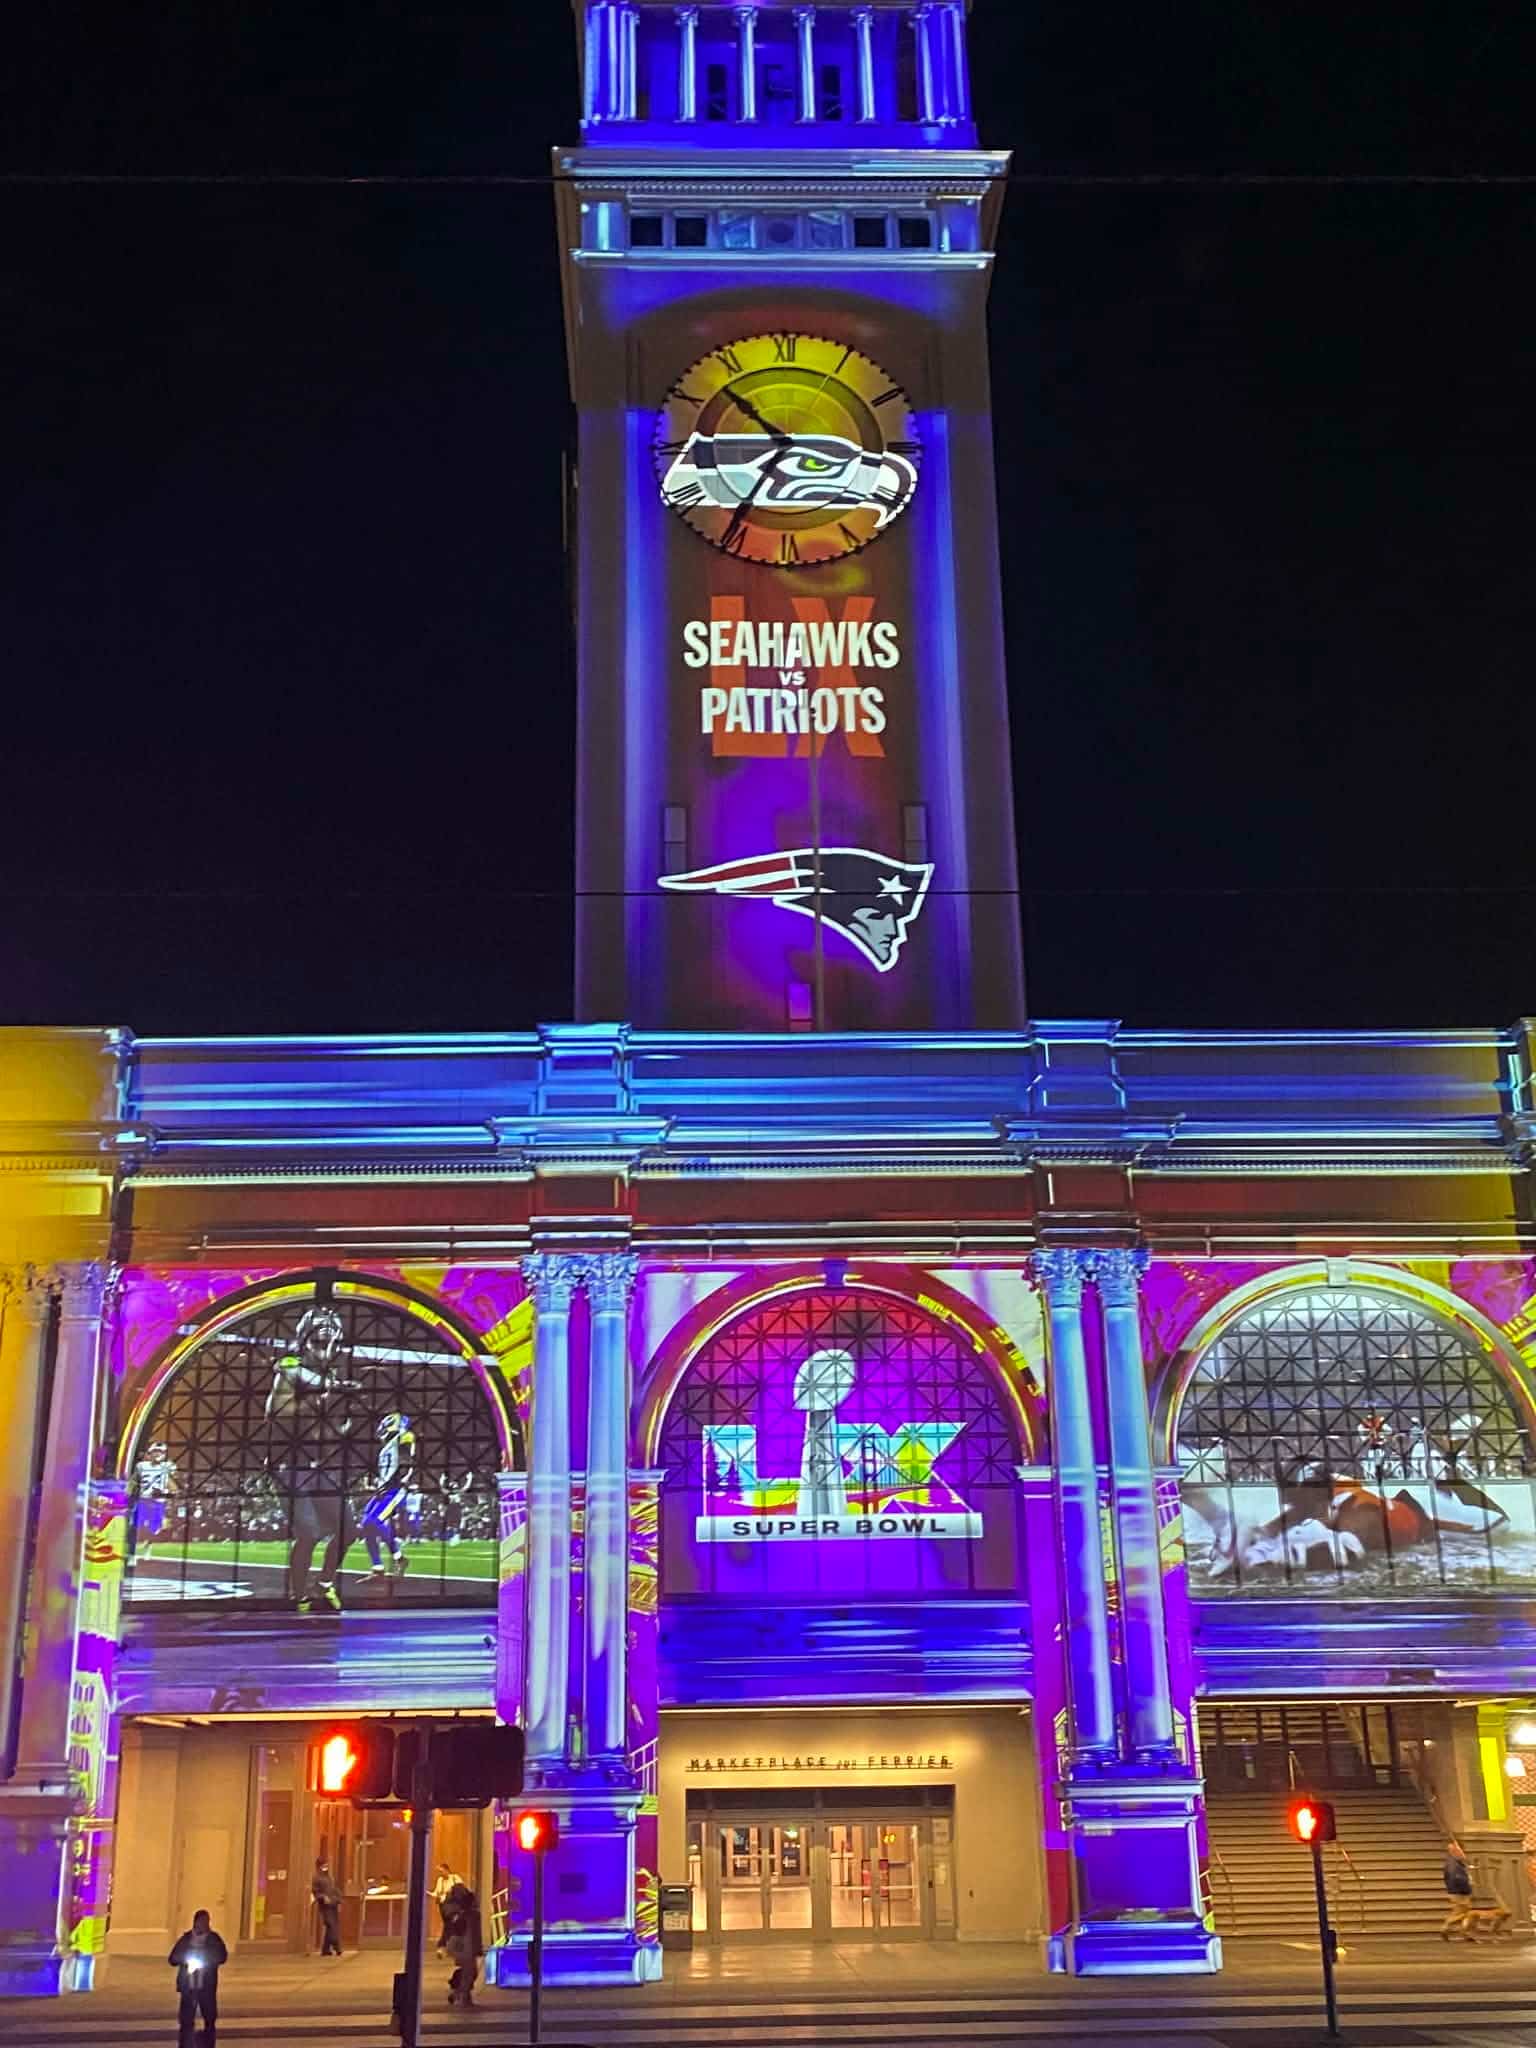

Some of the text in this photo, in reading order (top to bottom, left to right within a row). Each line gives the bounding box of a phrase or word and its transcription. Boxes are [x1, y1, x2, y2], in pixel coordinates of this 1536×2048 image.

[773, 337, 796, 363] XII
[683, 620, 900, 668] SEAHAWKS
[701, 686, 887, 734] PATRIOTS
[732, 1517, 947, 1536] SUPER BOWL
[690, 1755, 828, 1770] MARKETPLACE
